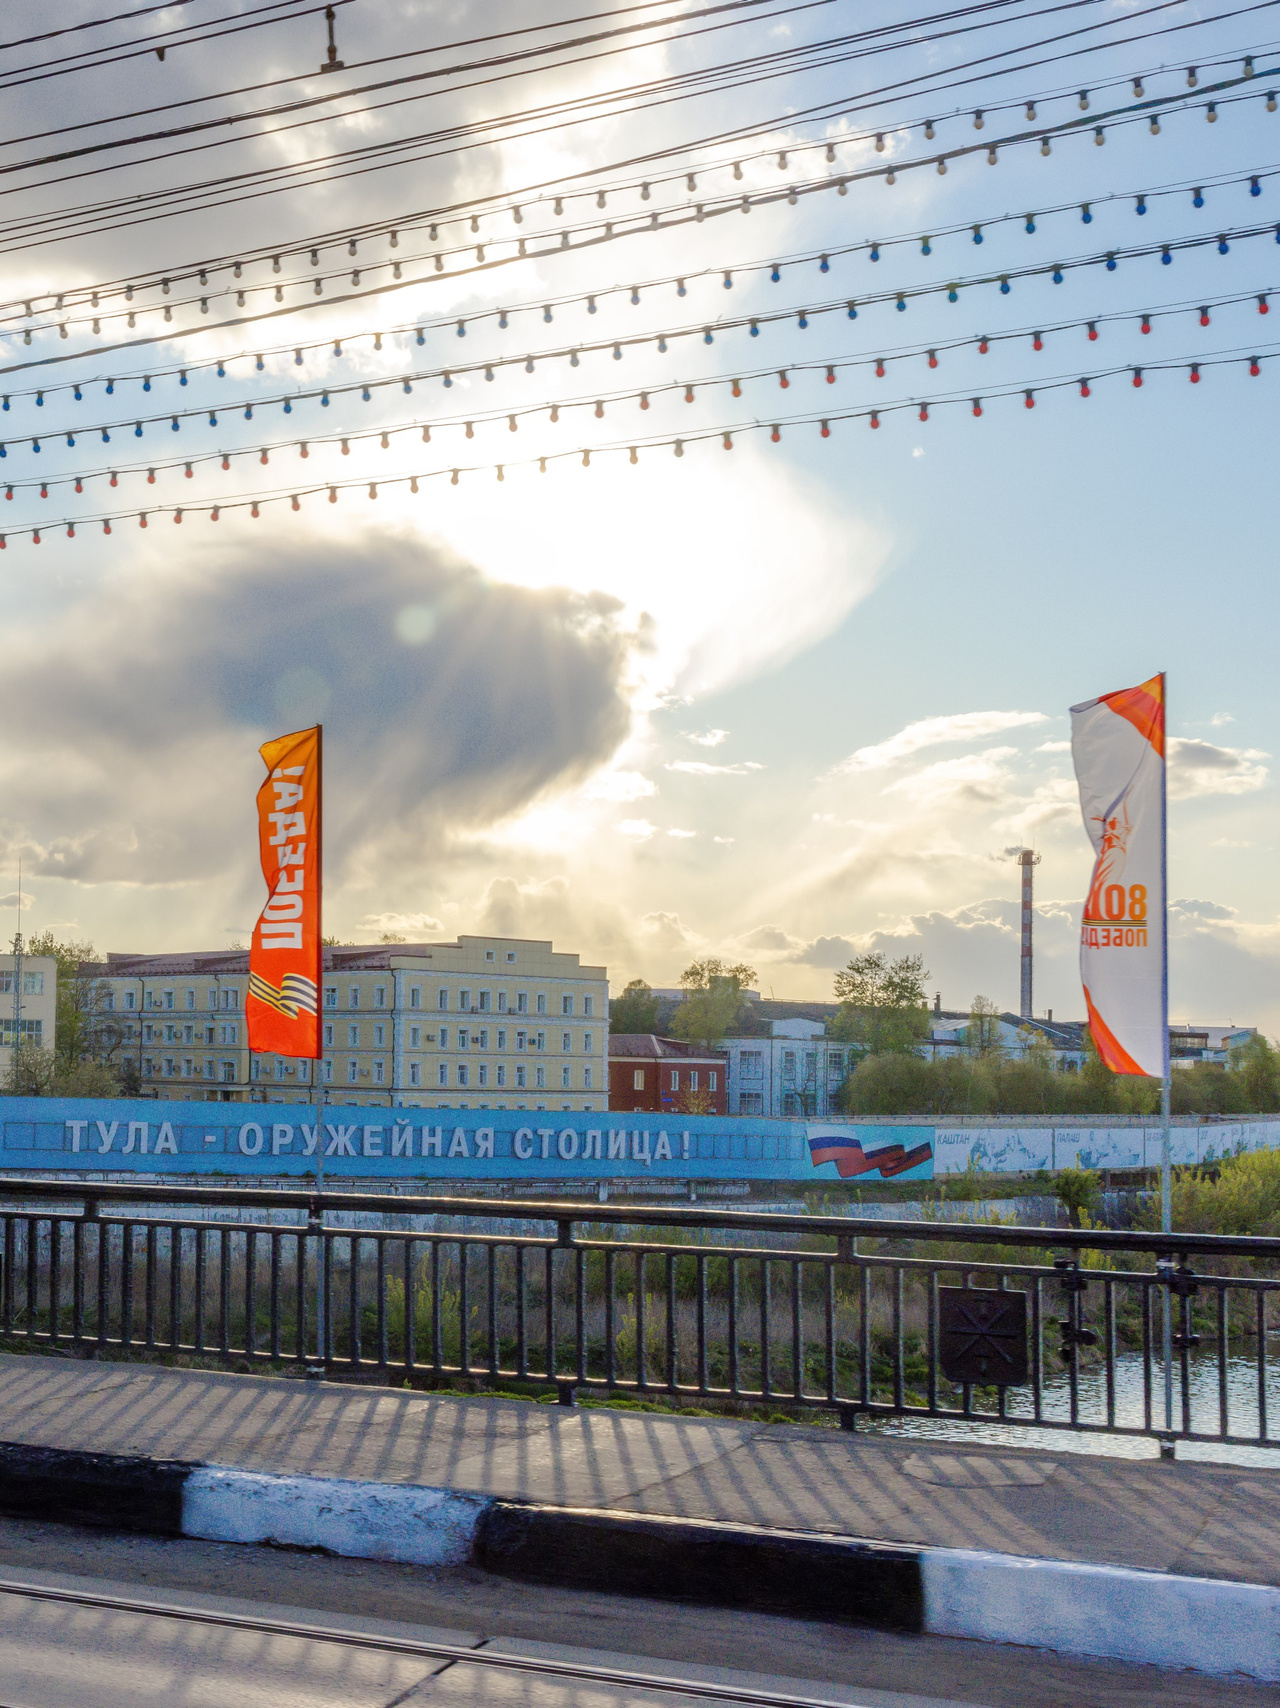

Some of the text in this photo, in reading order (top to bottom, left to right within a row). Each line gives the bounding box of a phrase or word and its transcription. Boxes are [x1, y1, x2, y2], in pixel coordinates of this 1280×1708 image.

[65, 1120, 179, 1154] ТУЛА
[238, 1118, 495, 1159] ОРУЖЕЙНАЯ
[513, 1127, 690, 1166] СТОЛИЦА!
[937, 1133, 970, 1145] КАШТАН
